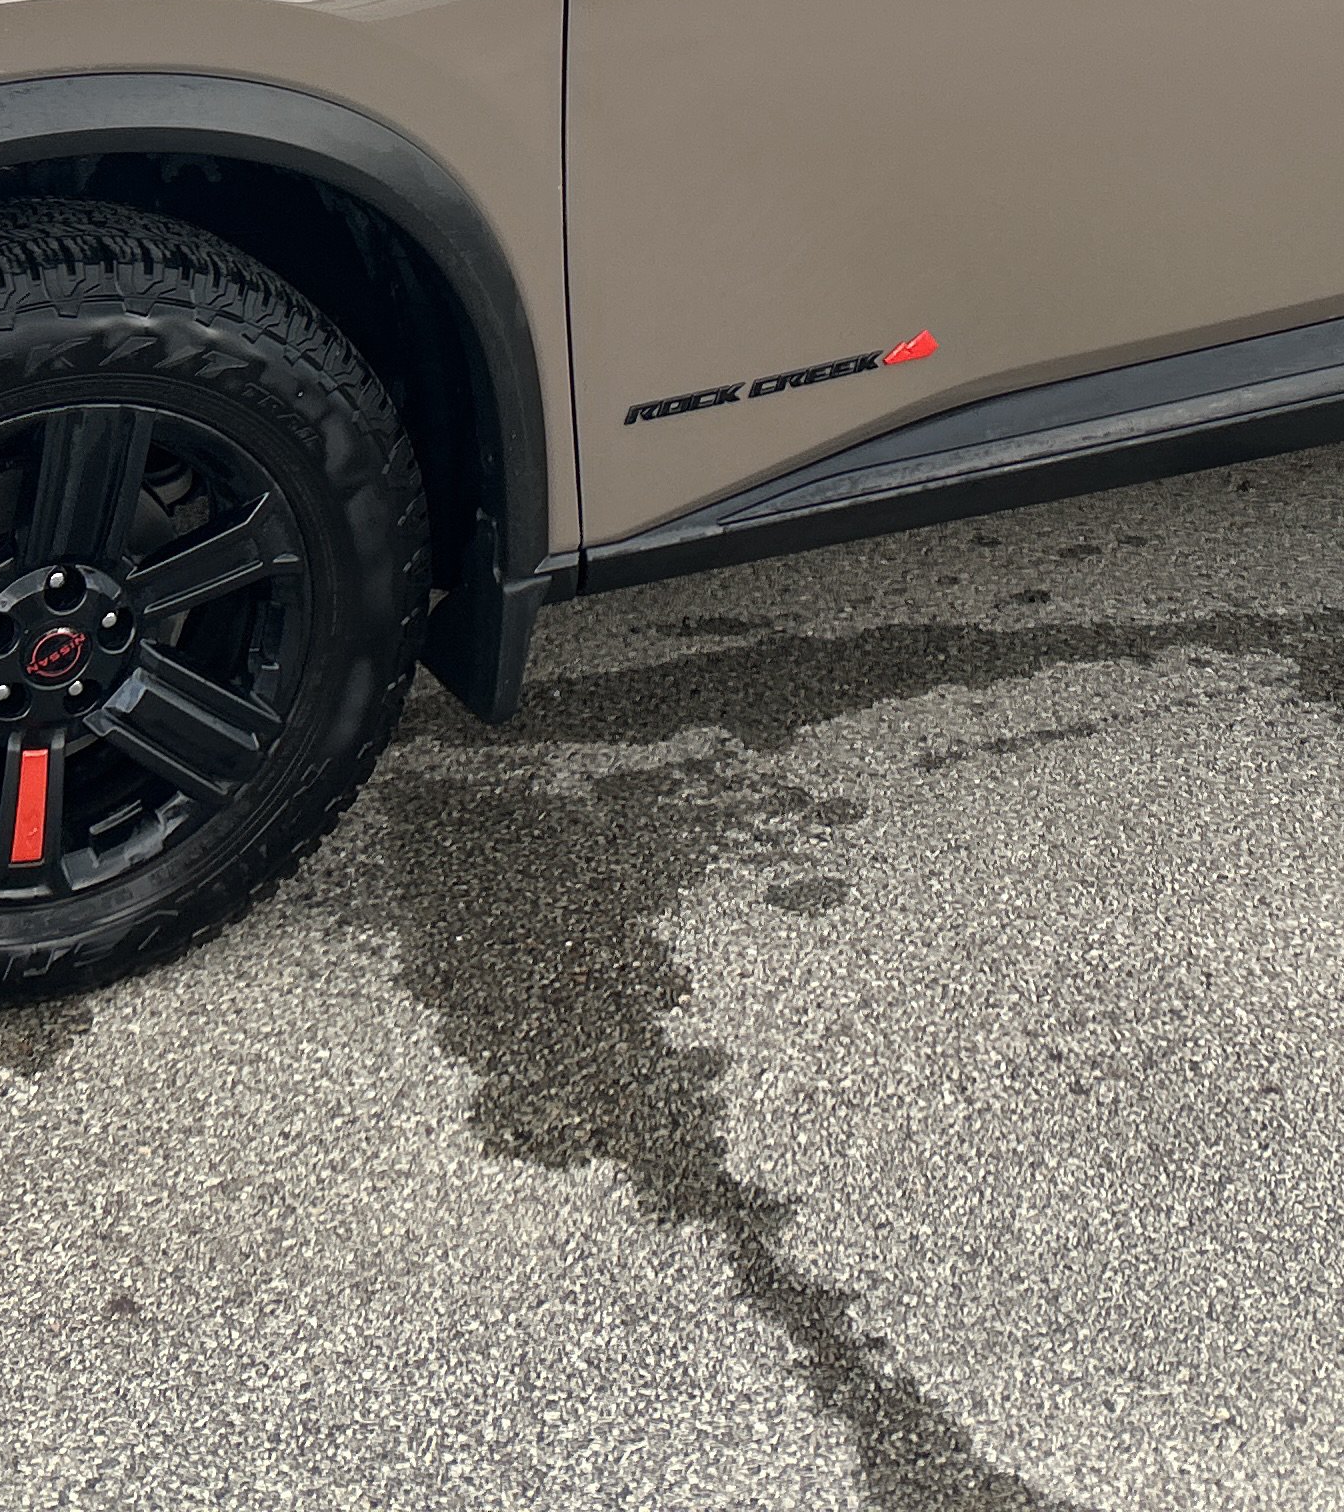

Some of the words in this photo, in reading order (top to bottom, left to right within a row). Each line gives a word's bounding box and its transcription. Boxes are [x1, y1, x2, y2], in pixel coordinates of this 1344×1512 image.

[623, 381, 747, 426] ROCK
[747, 349, 885, 399] CREEK
[26, 633, 86, 674] NISSAN
